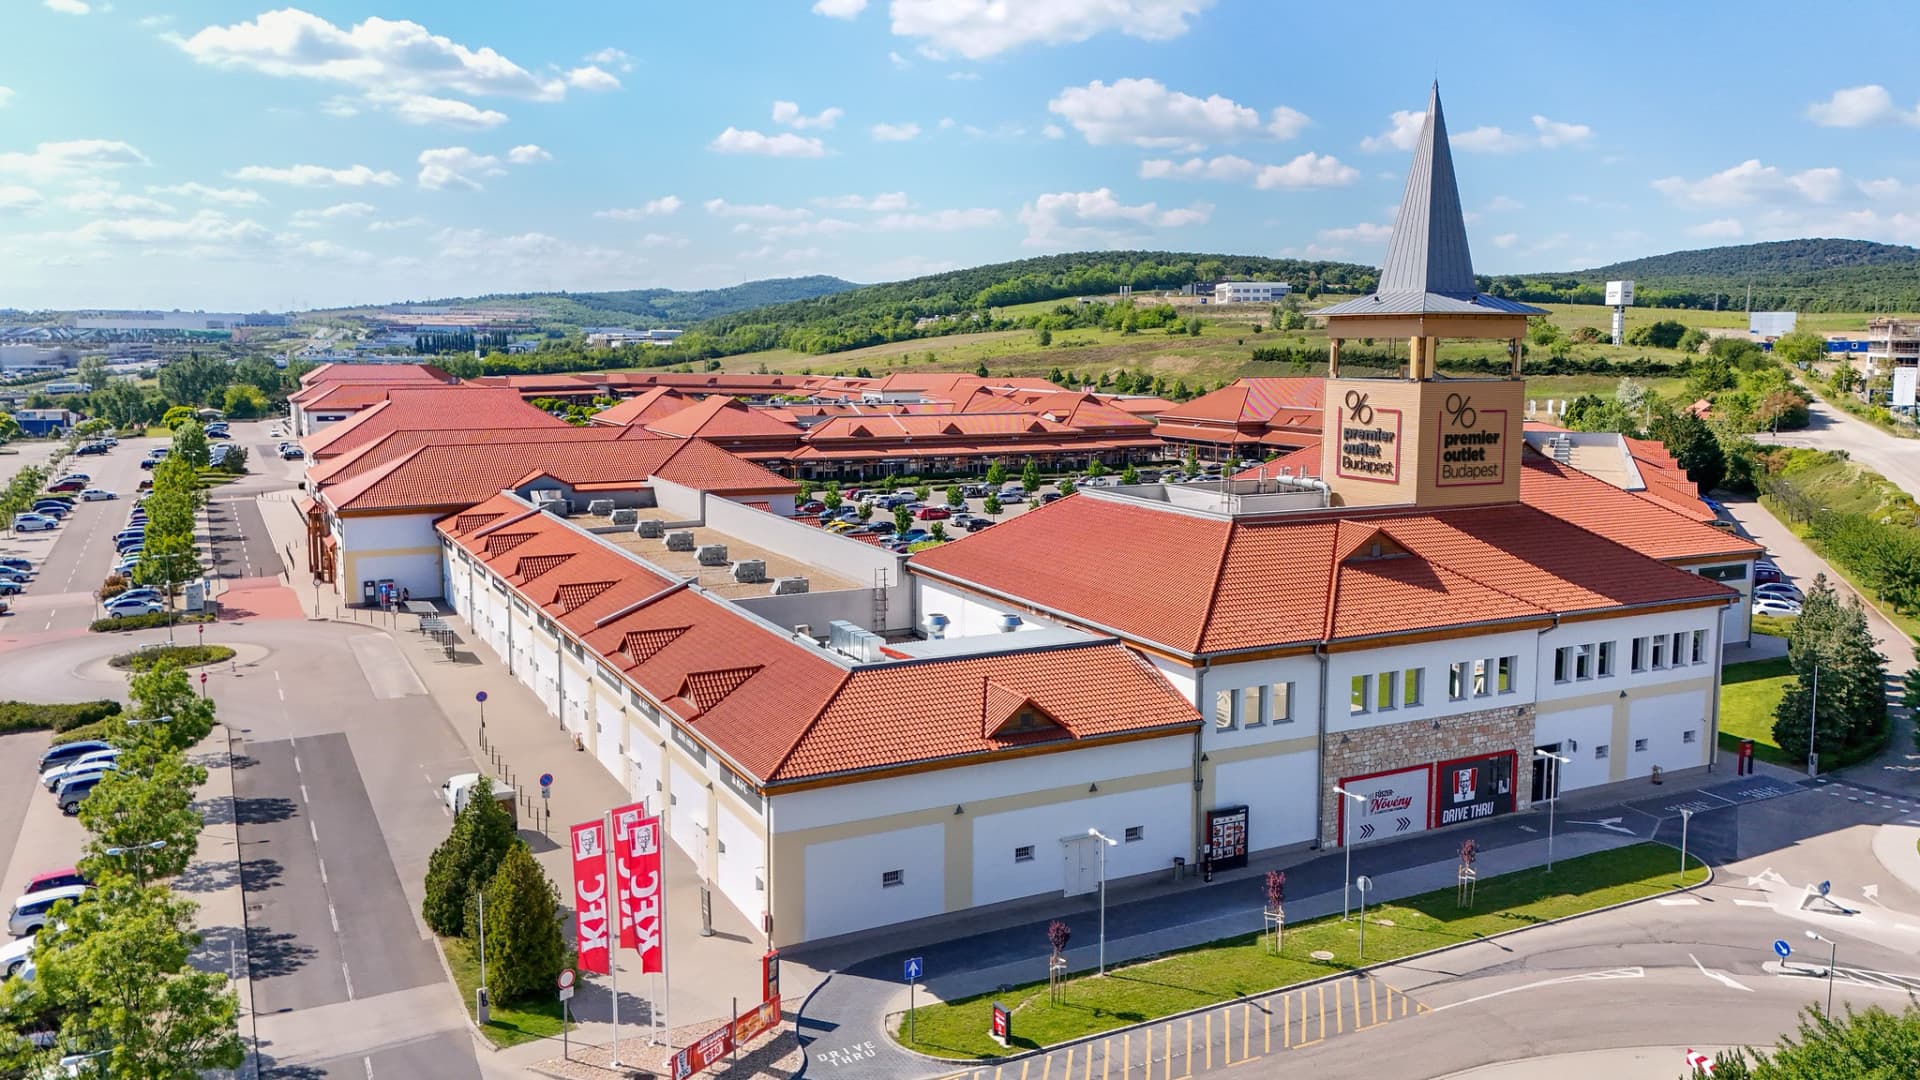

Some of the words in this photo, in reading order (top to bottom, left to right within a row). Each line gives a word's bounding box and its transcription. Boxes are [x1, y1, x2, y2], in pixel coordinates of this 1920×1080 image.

[1343, 427, 1395, 443] premier
[1444, 429, 1500, 448] premier
[1343, 442, 1382, 459] outlet
[1443, 447, 1486, 462] outlet
[1342, 456, 1394, 476] Budapest
[1442, 464, 1498, 480] Budapest
[1442, 806, 1469, 824] DRIVE
[1470, 801, 1494, 819] THRU
[577, 873, 607, 952] KFC
[631, 871, 660, 956] KFC
[816, 1040, 876, 1062] DRIVE
[829, 1049, 876, 1067] THRU
